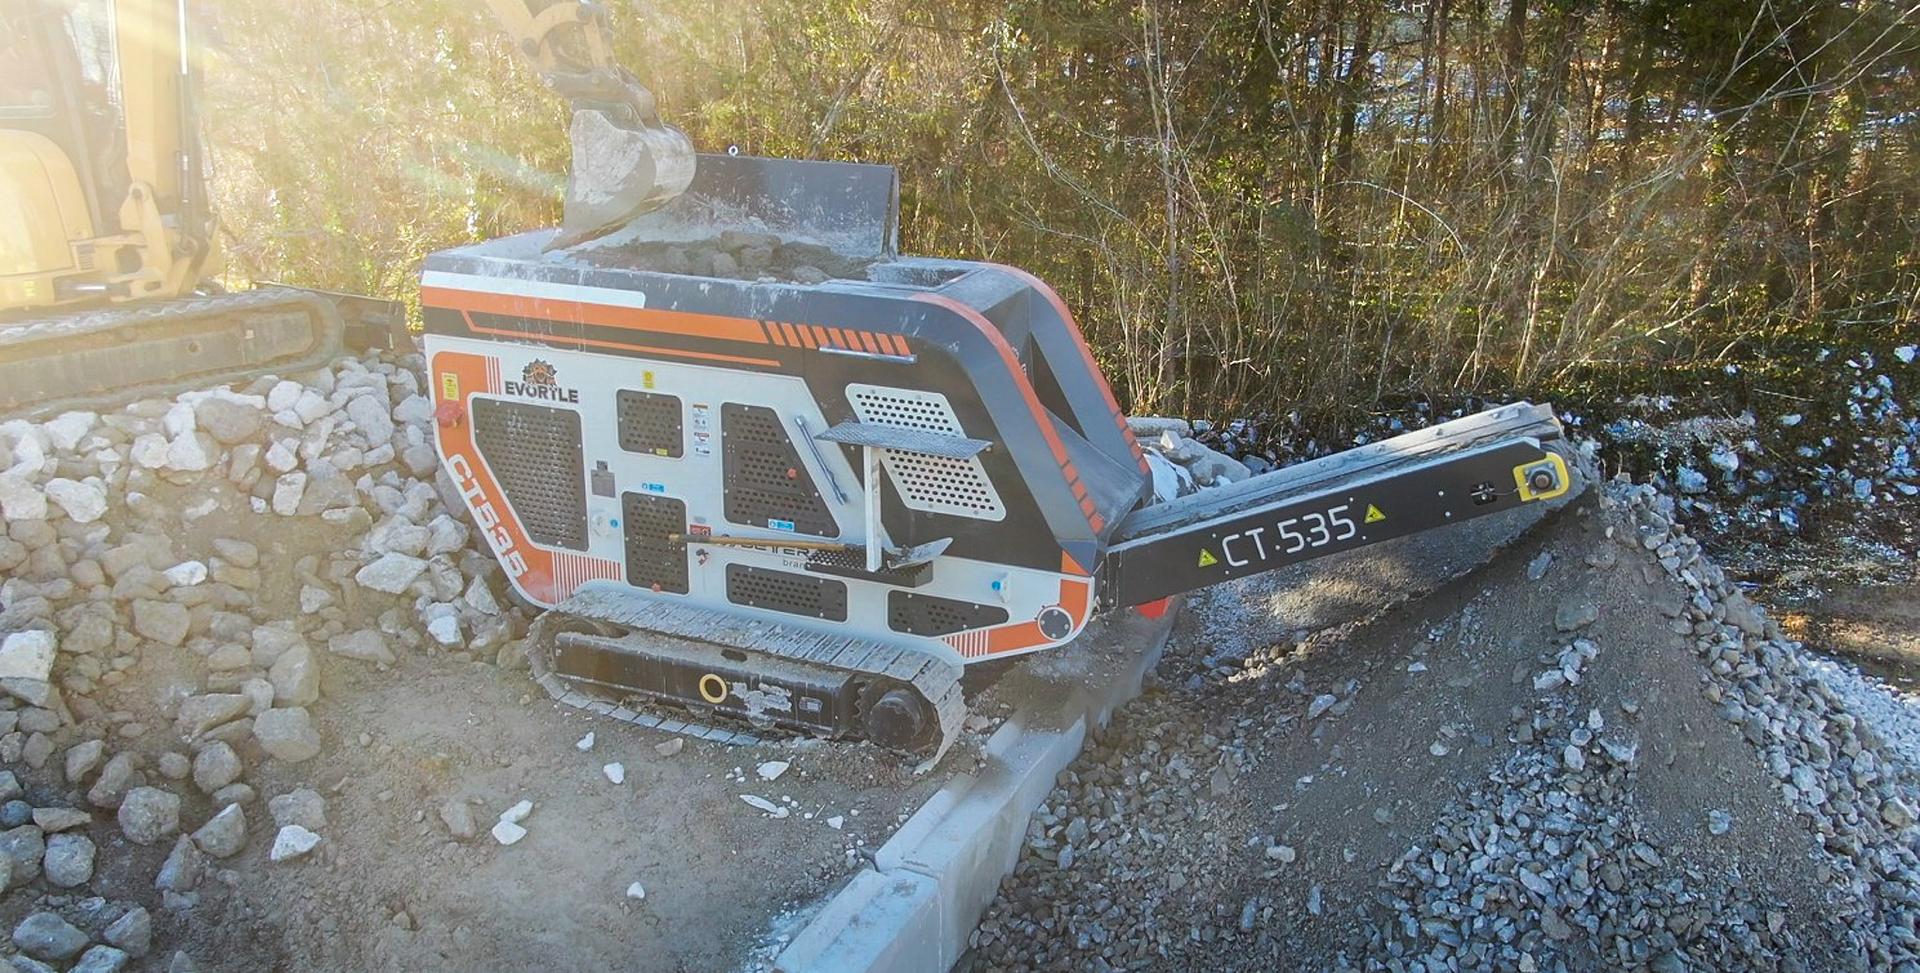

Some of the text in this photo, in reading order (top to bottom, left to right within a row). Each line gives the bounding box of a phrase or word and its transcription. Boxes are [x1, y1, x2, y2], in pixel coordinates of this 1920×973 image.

[504, 381, 579, 404] EVORTLE
[448, 453, 529, 578] CT535
[1222, 504, 1356, 567] CT 535
